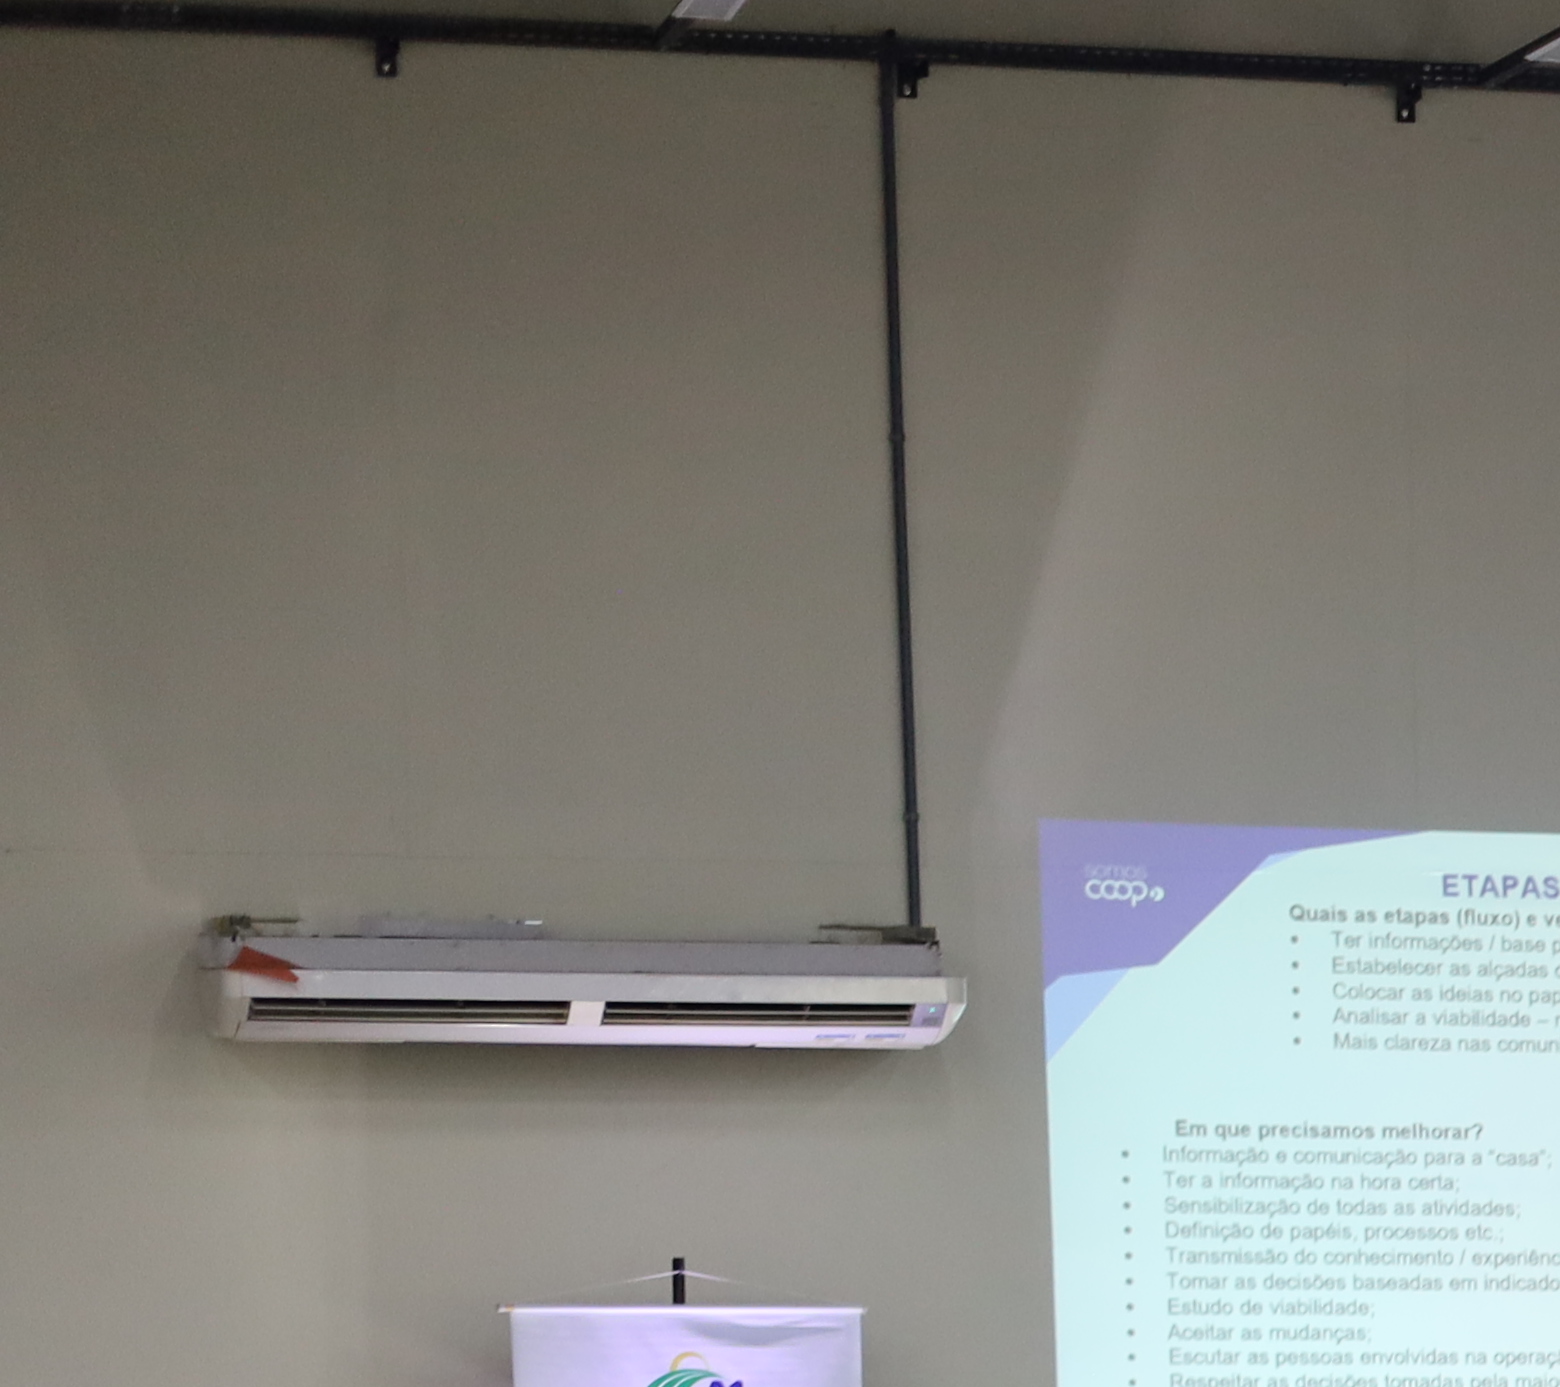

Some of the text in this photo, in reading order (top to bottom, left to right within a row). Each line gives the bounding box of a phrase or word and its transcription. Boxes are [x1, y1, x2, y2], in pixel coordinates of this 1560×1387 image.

[1085, 879, 1148, 908] coop
[1442, 874, 1559, 899] ETAPAS
[1289, 904, 1347, 923] Quais
[1355, 911, 1377, 923] as
[1384, 909, 1450, 927] etapas
[1457, 908, 1520, 929] (fluxo)
[1527, 915, 1536, 927] e
[1332, 932, 1362, 950] Ter
[1369, 932, 1483, 955] informações
[1488, 935, 1496, 951] /
[1501, 936, 1545, 954] base
[1332, 956, 1443, 977] Estabelecer
[1449, 962, 1471, 977] as
[1477, 959, 1548, 982] alçadas
[1332, 982, 1405, 1000] Colocar
[1412, 988, 1432, 1001] as
[1439, 984, 1493, 1003] ideias
[1500, 990, 1523, 1003] no
[1332, 1007, 1407, 1025] Analisar
[1415, 1013, 1426, 1026] a
[1432, 1009, 1531, 1027] viabilidade
[1333, 1032, 1377, 1050] Mais
[1384, 1035, 1451, 1052] clareza
[1458, 1040, 1490, 1053] nas
[1175, 1119, 1483, 1141] Em que precisamos melhorar?
[1163, 1145, 1268, 1168] Informação
[1276, 1150, 1287, 1163] e
[1294, 1148, 1416, 1169] comunicação
[1424, 1152, 1465, 1168] para
[1472, 1153, 1483, 1165] a
[1164, 1172, 1460, 1193] Ter a informação na hora certa;
[1168, 1273, 1229, 1290] Tomar
[1235, 1278, 1255, 1290] as
[1263, 1274, 1346, 1291] decisões
[1353, 1274, 1442, 1291] baseadas
[1450, 1279, 1477, 1291] em
[1168, 1298, 1375, 1318] Estudo de viabilidade;
[1168, 1324, 1372, 1344] Aceitar as mudanças;
